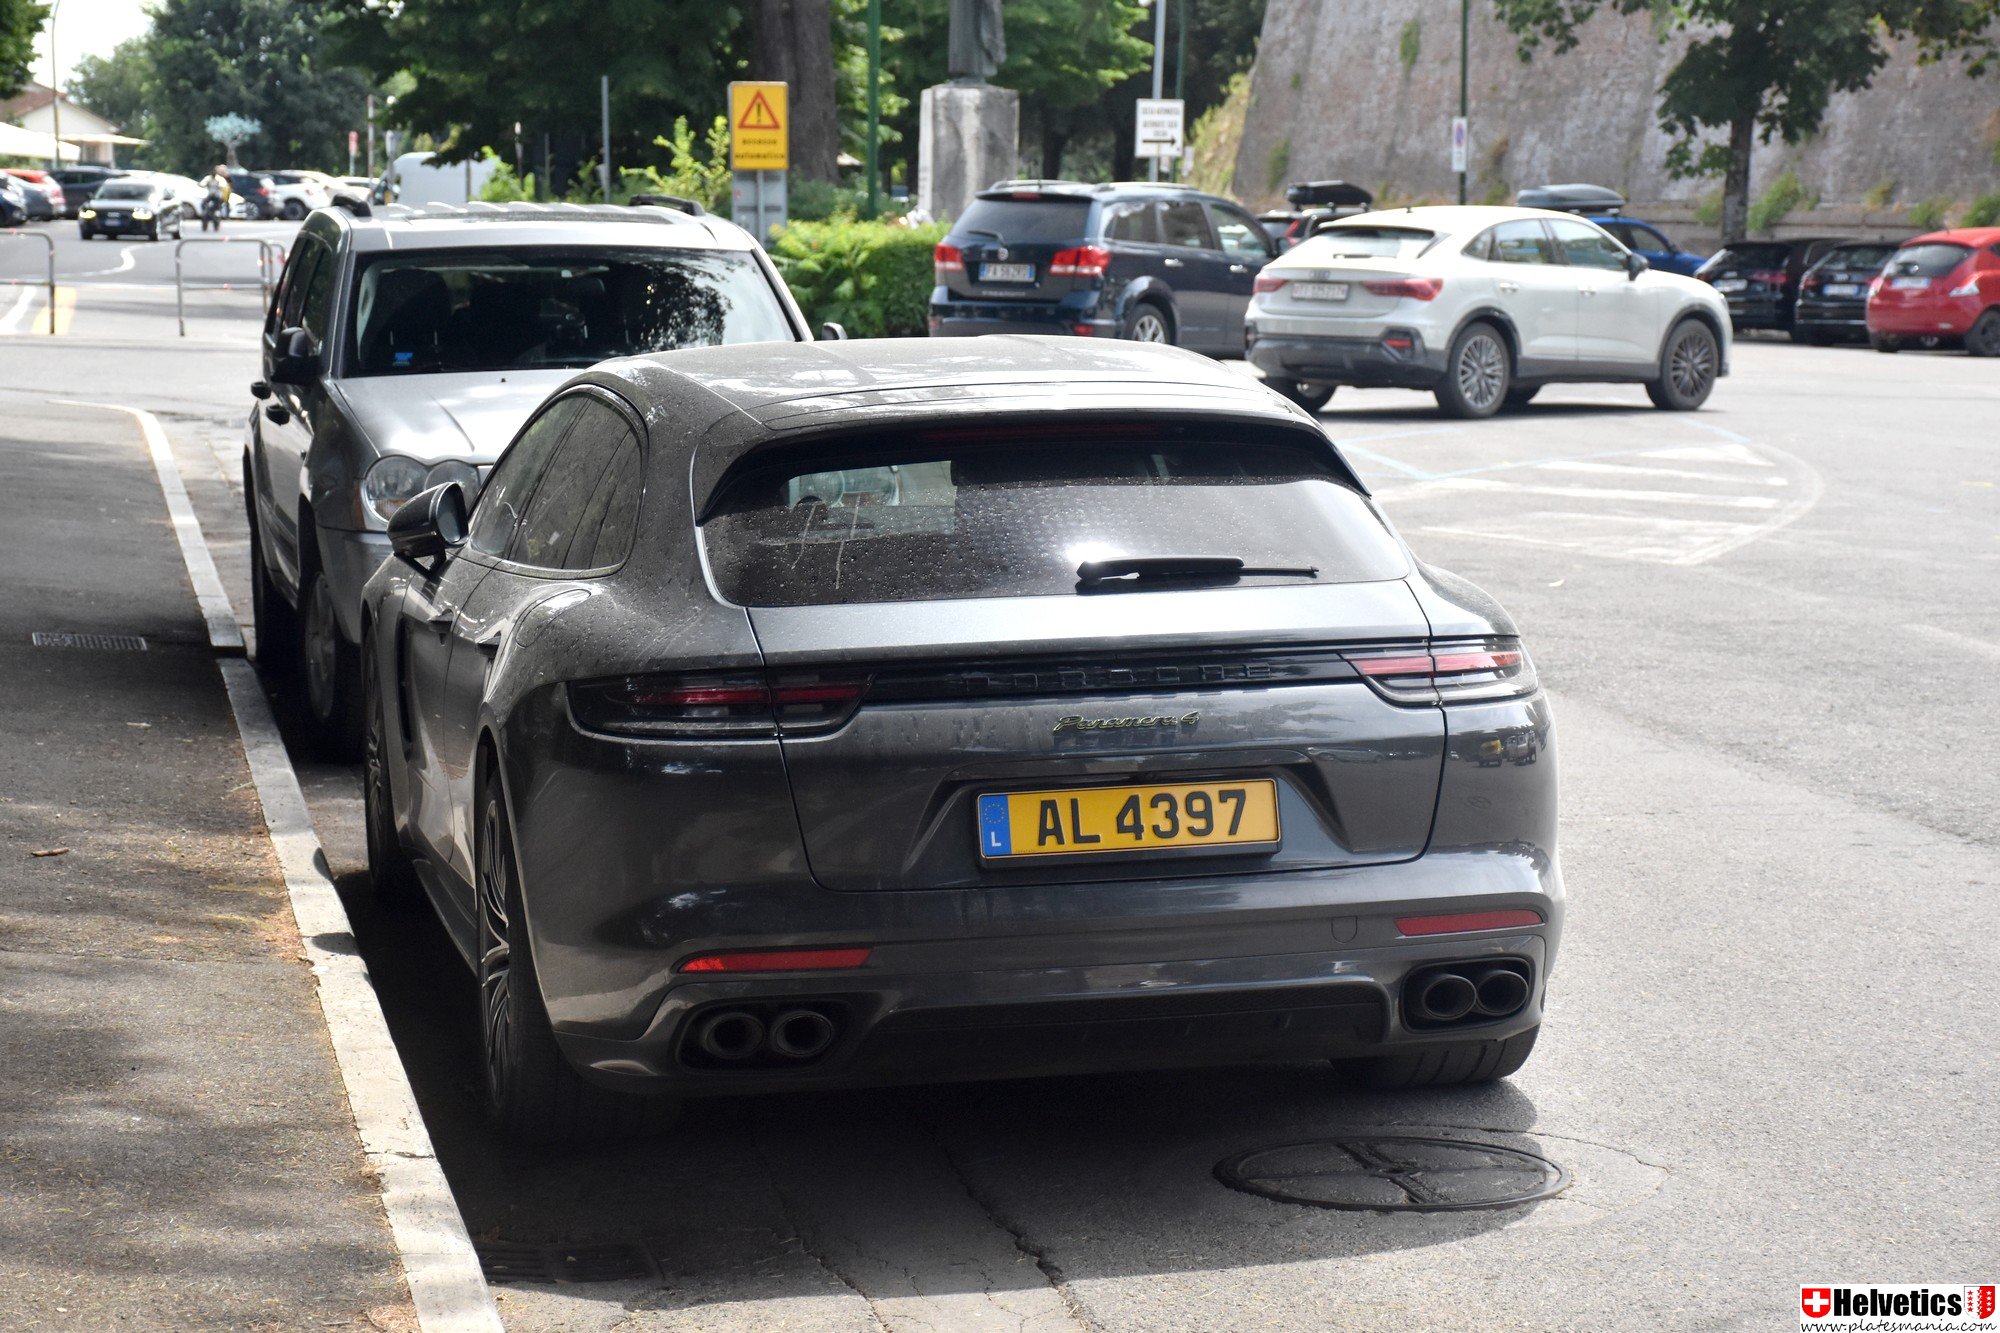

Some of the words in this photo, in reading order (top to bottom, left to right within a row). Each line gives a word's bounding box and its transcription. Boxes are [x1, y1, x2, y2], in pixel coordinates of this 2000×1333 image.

[1053, 714, 1178, 732] Panamera
[1181, 711, 1200, 725] 4
[1038, 798, 1101, 846] AL
[1116, 789, 1246, 841] 4397
[990, 832, 1001, 847] L
